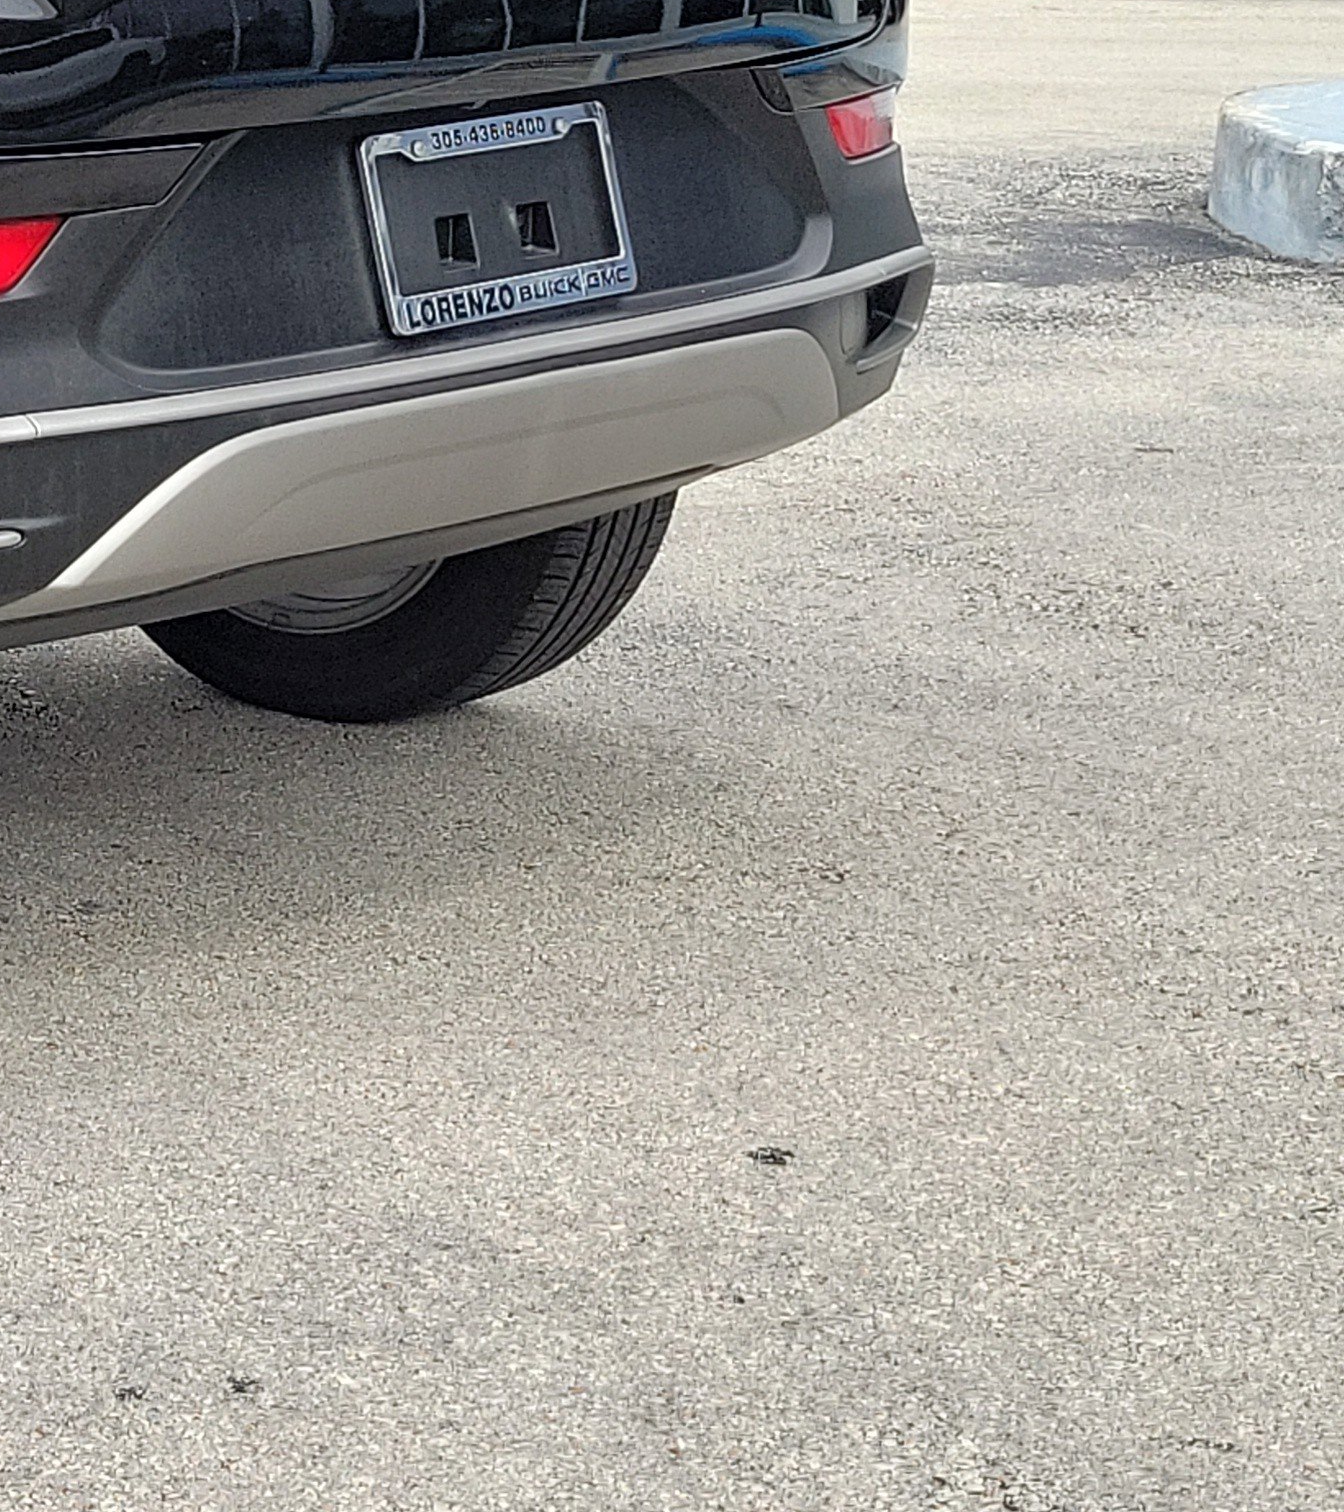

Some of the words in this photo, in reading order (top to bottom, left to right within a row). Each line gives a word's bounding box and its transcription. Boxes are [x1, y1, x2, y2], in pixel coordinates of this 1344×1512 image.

[405, 283, 515, 329] LORENZO
[519, 277, 581, 303] BUICK
[585, 266, 630, 289] GMC
